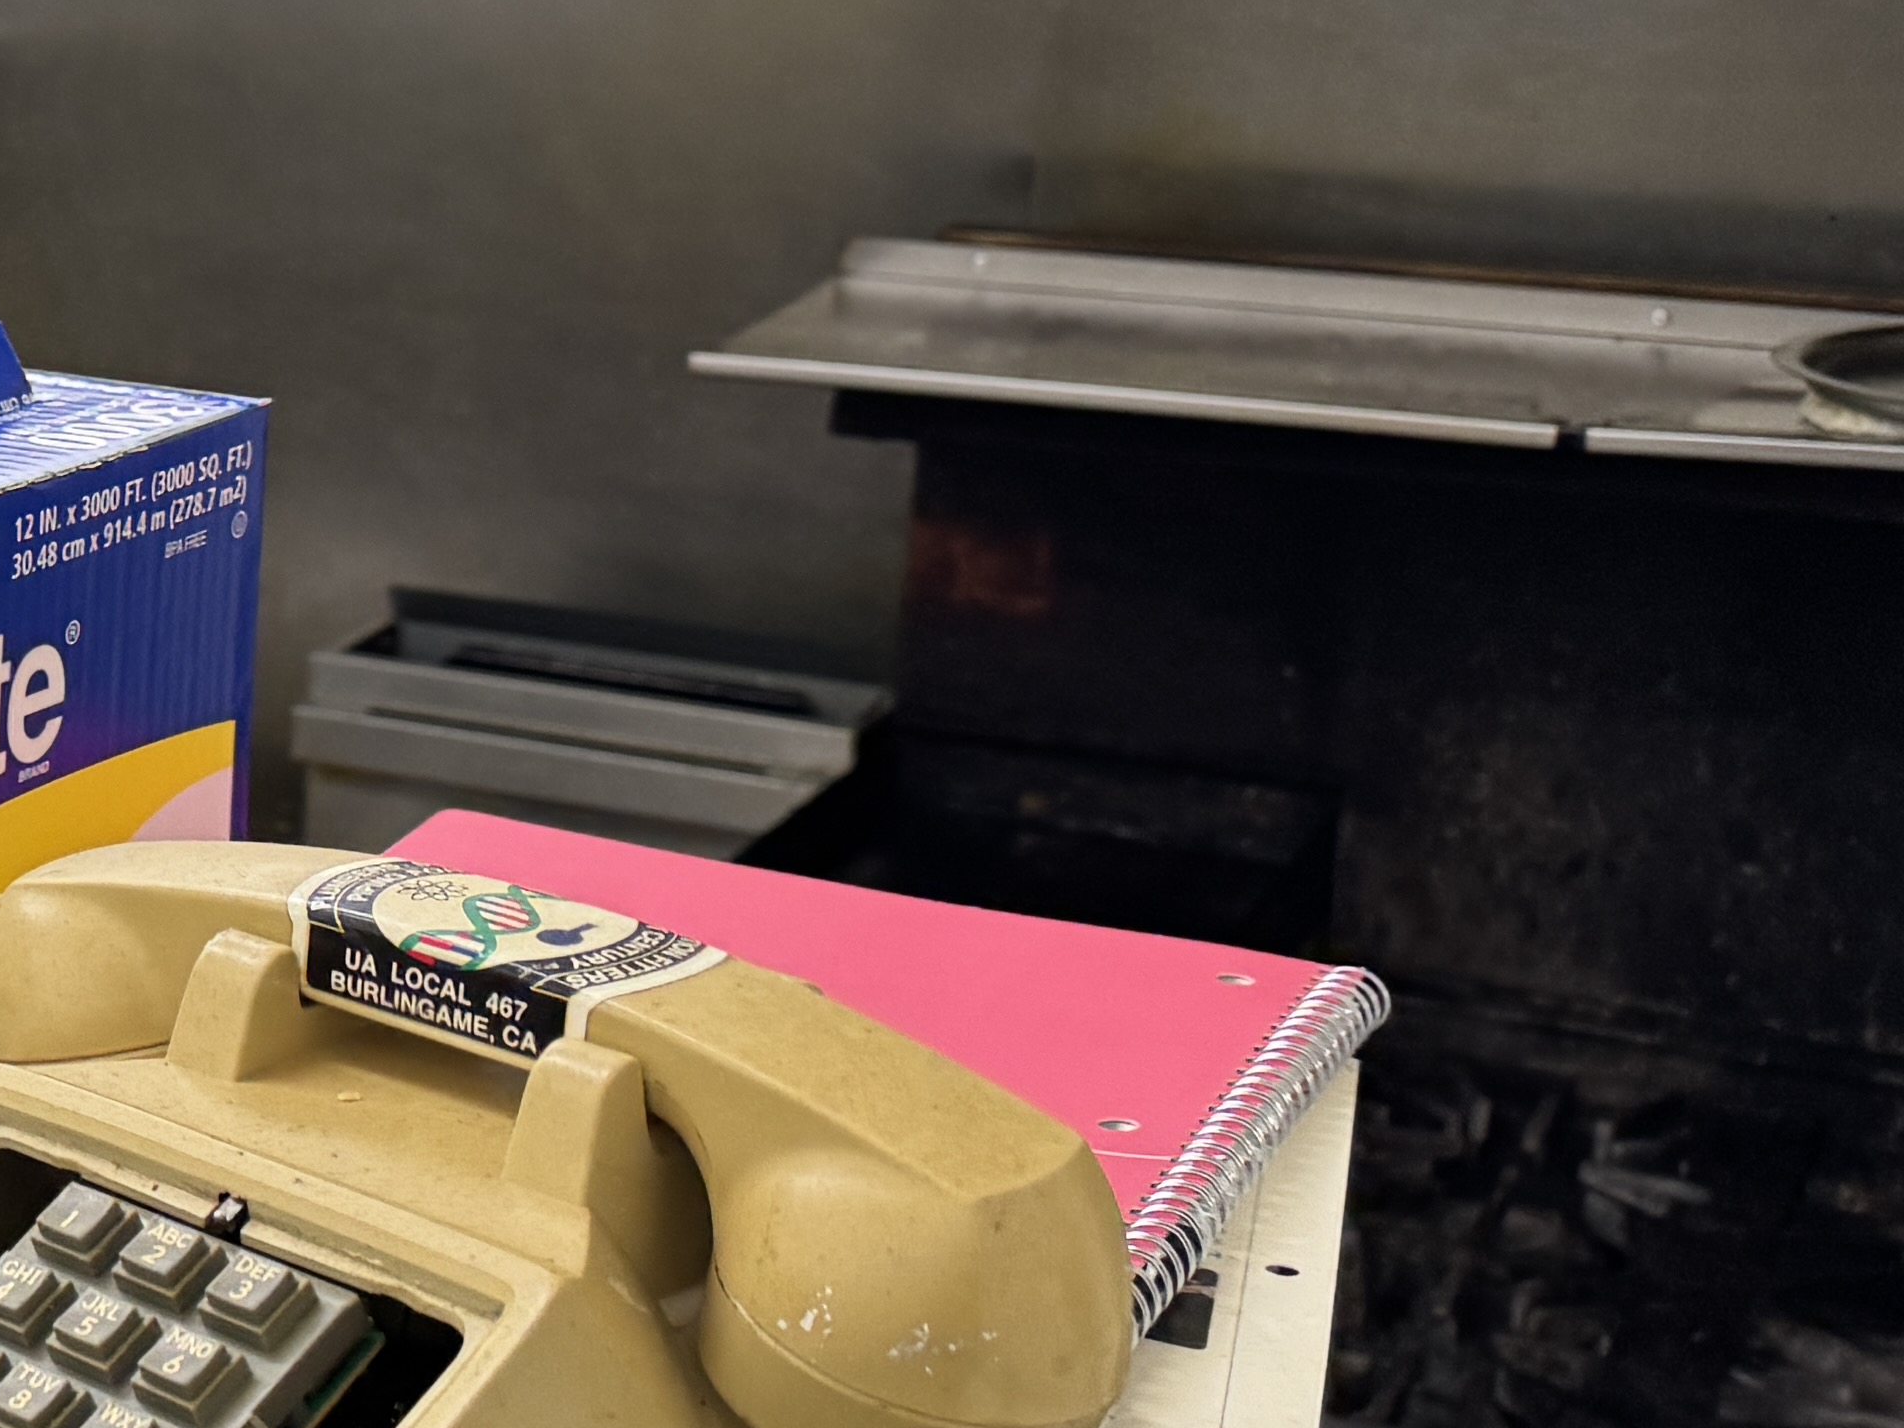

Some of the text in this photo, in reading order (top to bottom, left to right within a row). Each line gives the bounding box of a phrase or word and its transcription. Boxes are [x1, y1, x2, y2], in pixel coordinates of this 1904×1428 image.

[15, 440, 253, 542] 12 IN. x 3000 FT. (3000 SQ. FT.)
[11, 542, 57, 580] 30.48
[62, 537, 85, 563] cm
[103, 515, 148, 549] 914.4
[150, 512, 166, 533] m
[169, 488, 216, 529] (278.7
[345, 946, 530, 1024] UA LOCAL 467
[565, 953, 674, 989] FITTERS
[330, 969, 539, 1057] BURLINGAME, CA
[58, 1208, 77, 1230] 1
[146, 1220, 192, 1251] ABC
[145, 1243, 168, 1266] 2
[0, 1259, 41, 1287] GHI
[233, 1256, 280, 1285] DEF
[228, 1276, 255, 1301] 3
[81, 1291, 118, 1322] JKL
[74, 1314, 95, 1338] 5
[166, 1329, 213, 1360] MNO
[18, 1361, 60, 1393] TUV
[163, 1351, 185, 1375] 6
[8, 1386, 32, 1410] 8
